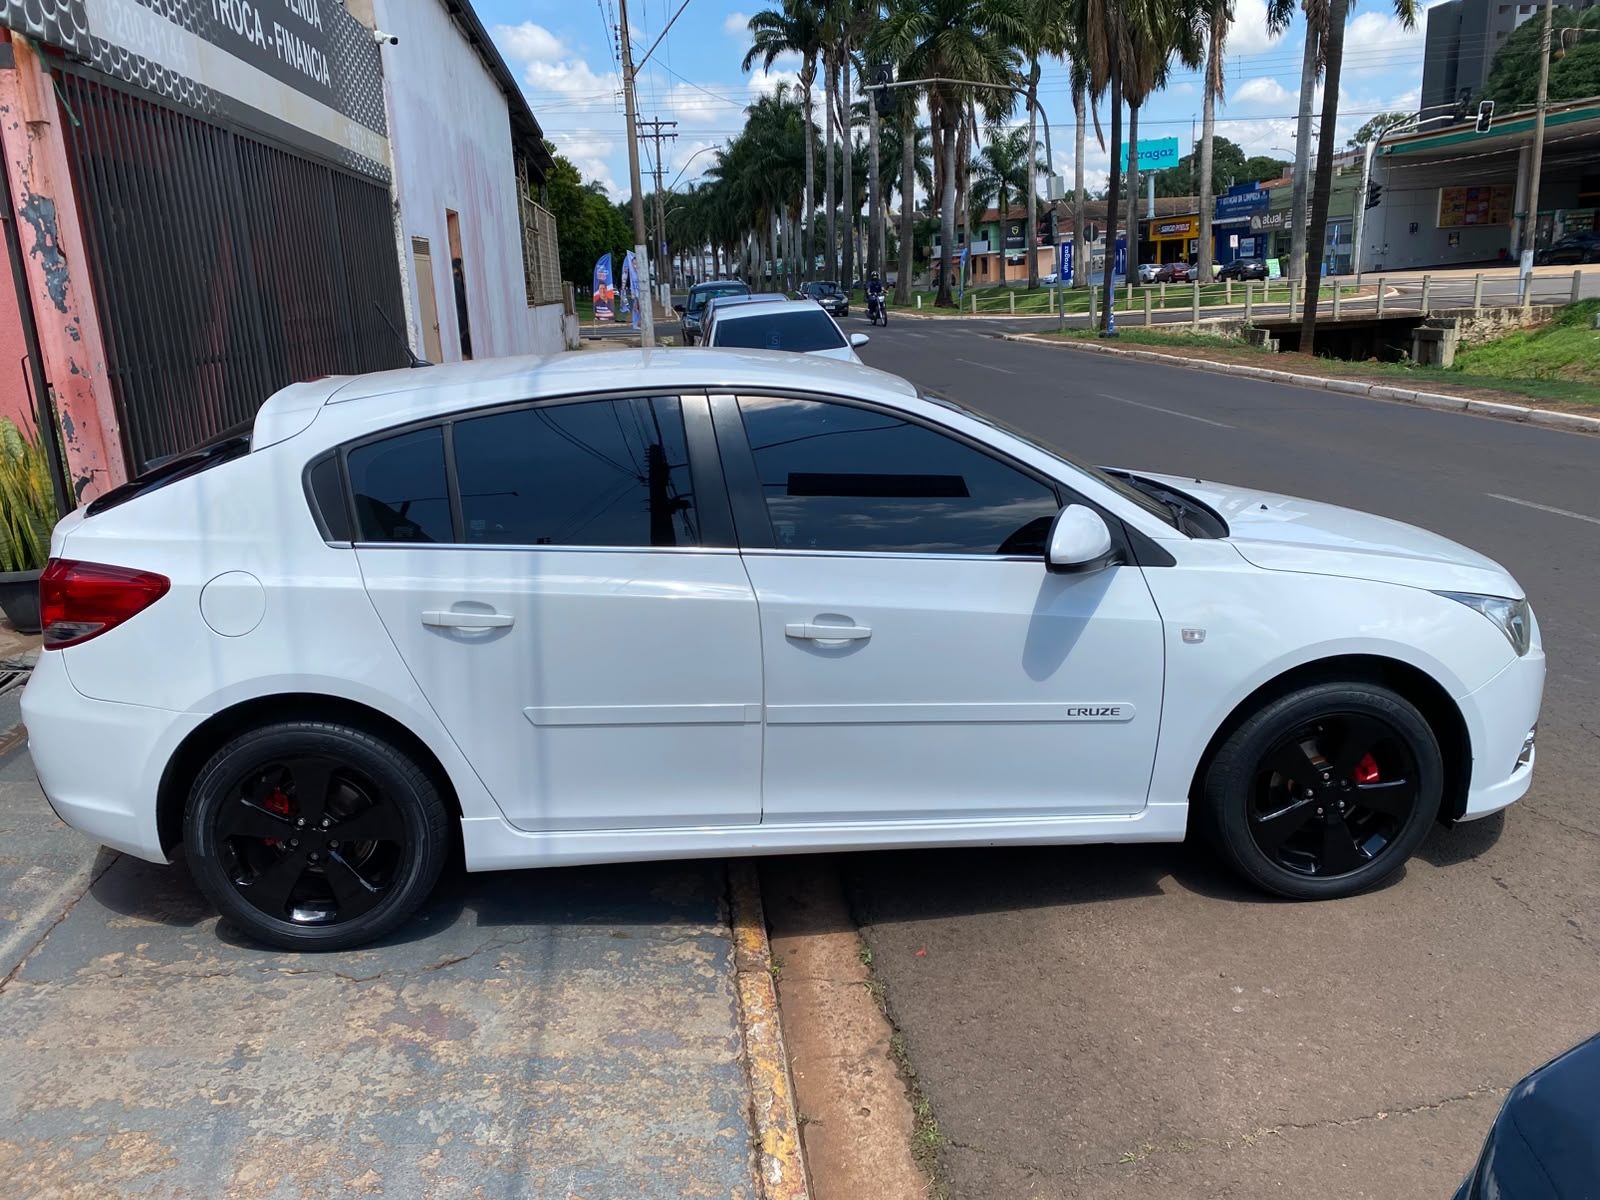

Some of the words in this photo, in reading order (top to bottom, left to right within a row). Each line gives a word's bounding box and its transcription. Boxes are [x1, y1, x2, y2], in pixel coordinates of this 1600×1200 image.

[284, 0, 323, 32] NDA
[273, 21, 332, 89] FINANCIA
[1126, 149, 1174, 161] tragaz
[1262, 212, 1282, 224] atual
[1067, 707, 1121, 717] CRUZE
